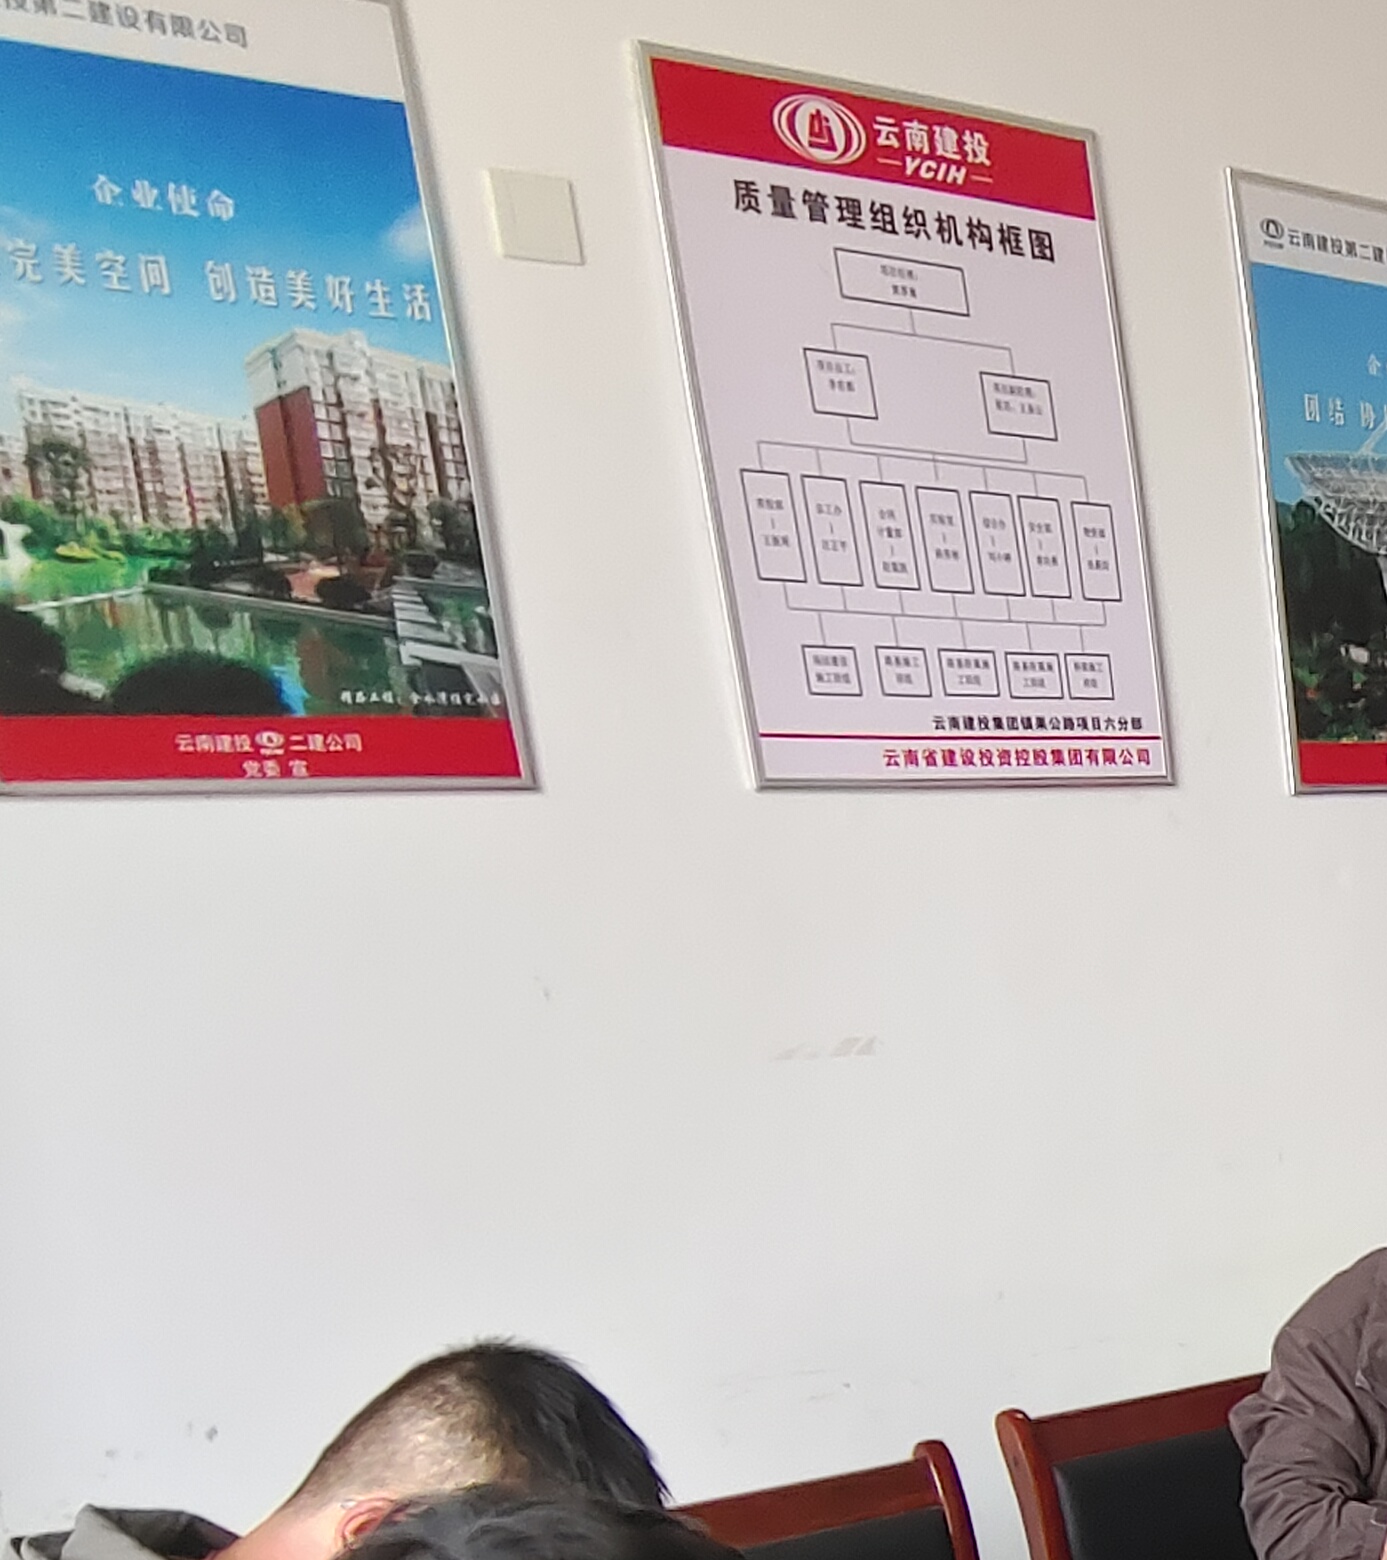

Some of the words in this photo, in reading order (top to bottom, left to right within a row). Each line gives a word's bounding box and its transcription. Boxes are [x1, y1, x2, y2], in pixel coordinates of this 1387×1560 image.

[872, 115, 991, 167] 云南建投
[90, 173, 236, 222] 企业使命
[732, 178, 1056, 263] 质量管理组织机构框图
[6, 238, 171, 296] 完美空间
[204, 259, 433, 323] 创造美好生活
[1304, 393, 1345, 426] 团结
[289, 732, 363, 753] 二建公司
[882, 748, 1151, 768] 云南省建设投资控股集团有限公司
